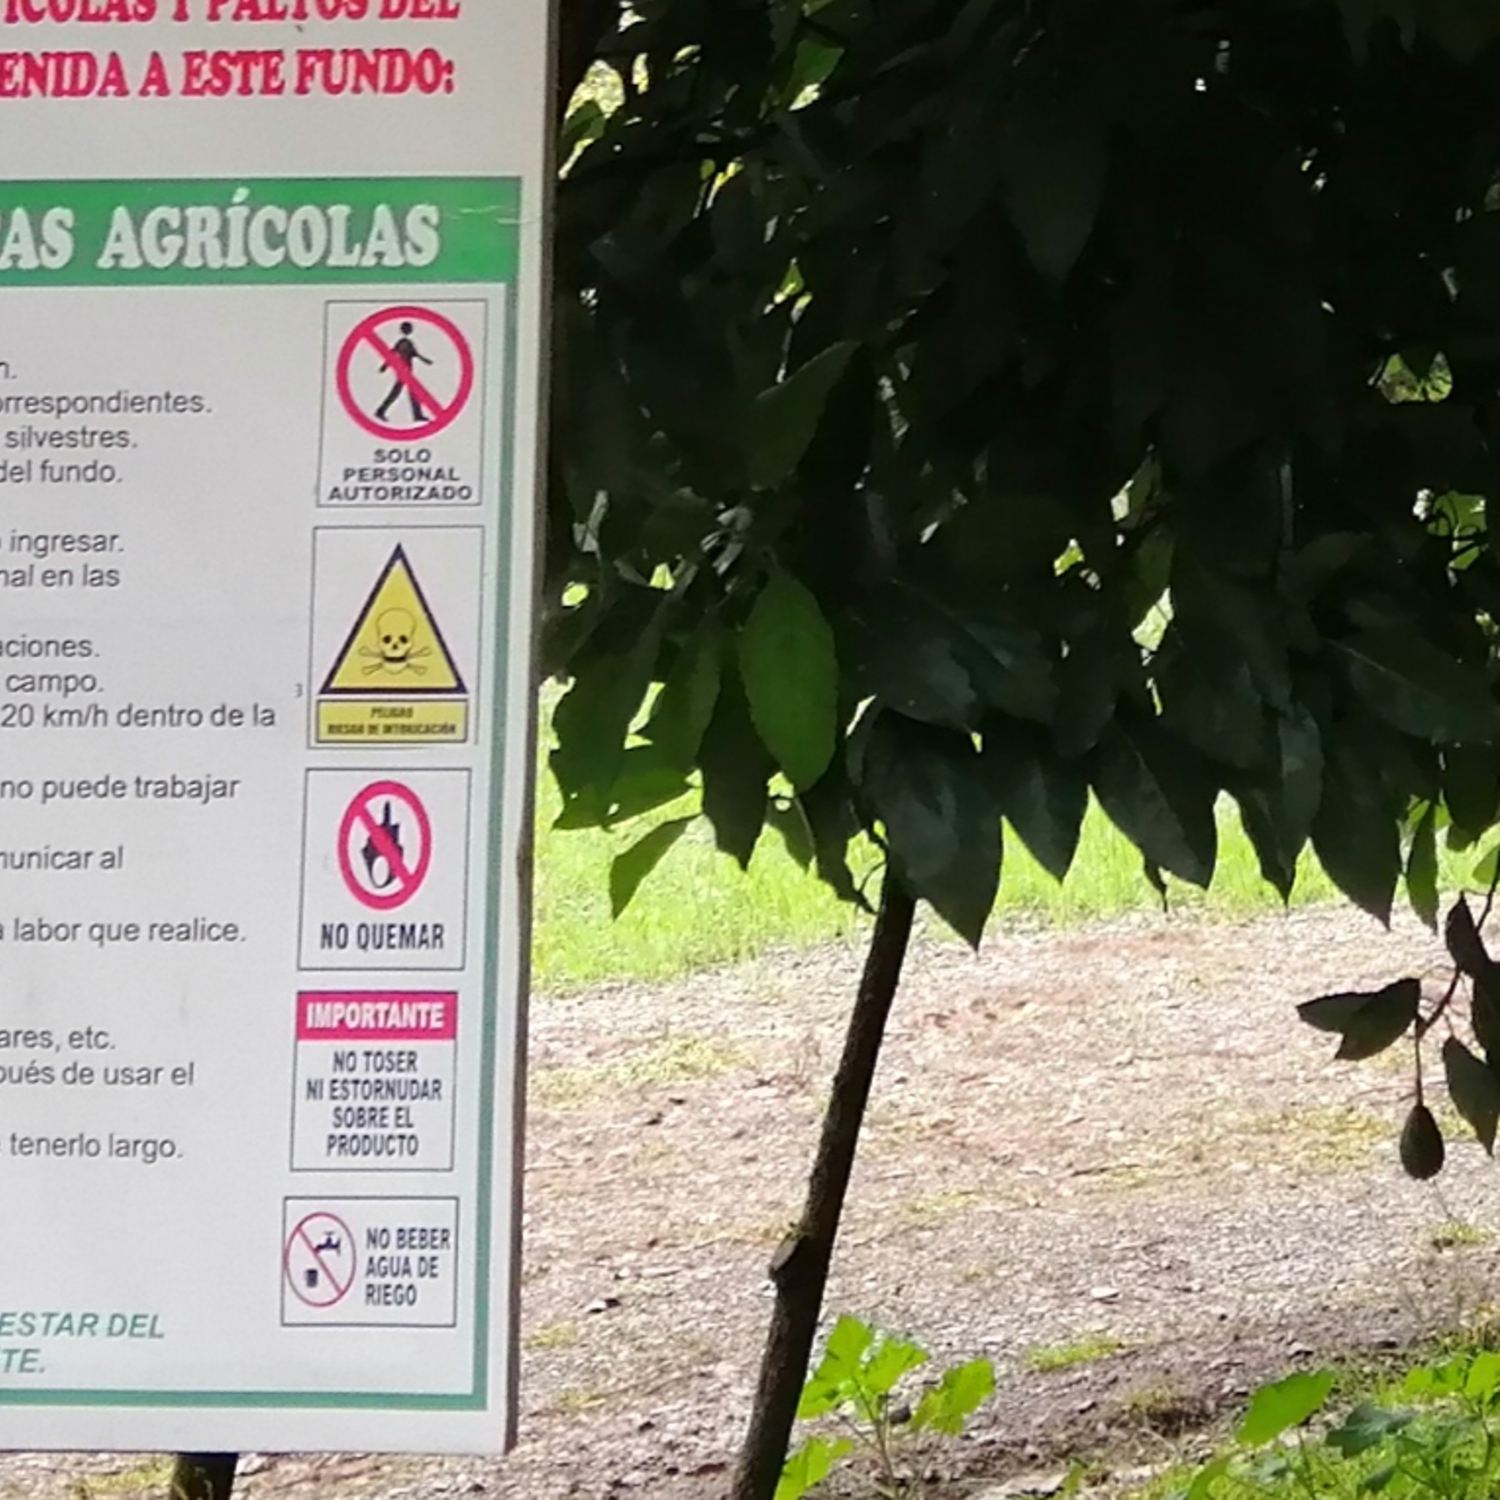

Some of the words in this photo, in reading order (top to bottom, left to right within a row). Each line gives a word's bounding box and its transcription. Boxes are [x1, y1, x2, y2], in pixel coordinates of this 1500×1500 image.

[139, 54, 170, 97] A
[182, 50, 285, 97] ESTE
[295, 47, 454, 96] FUNDO:
[97, 188, 440, 269] AGRÍCOLAS
[5, 425, 137, 449] silvestres.
[374, 447, 432, 464] SOLO
[343, 466, 460, 483] PERSONAL
[328, 485, 472, 501] AUTORIZADO
[321, 923, 348, 950] NO
[357, 923, 444, 952] QUEMAR
[307, 1001, 444, 1029] IMPORTANTE
[333, 1050, 357, 1073] NO
[363, 1049, 417, 1073] TOSER
[307, 1078, 323, 1100] NI
[329, 1077, 441, 1101] ESTORNUDAR
[333, 1105, 389, 1129] SOBRE
[394, 1106, 414, 1129] EL
[327, 1133, 419, 1157] PRODUCTO
[366, 1227, 390, 1250] NO
[396, 1227, 450, 1250] BEBER
[365, 1255, 412, 1279] AGUA
[418, 1255, 439, 1278] DE
[366, 1283, 417, 1307] RIEGO
[106, 1313, 164, 1339] DEL
